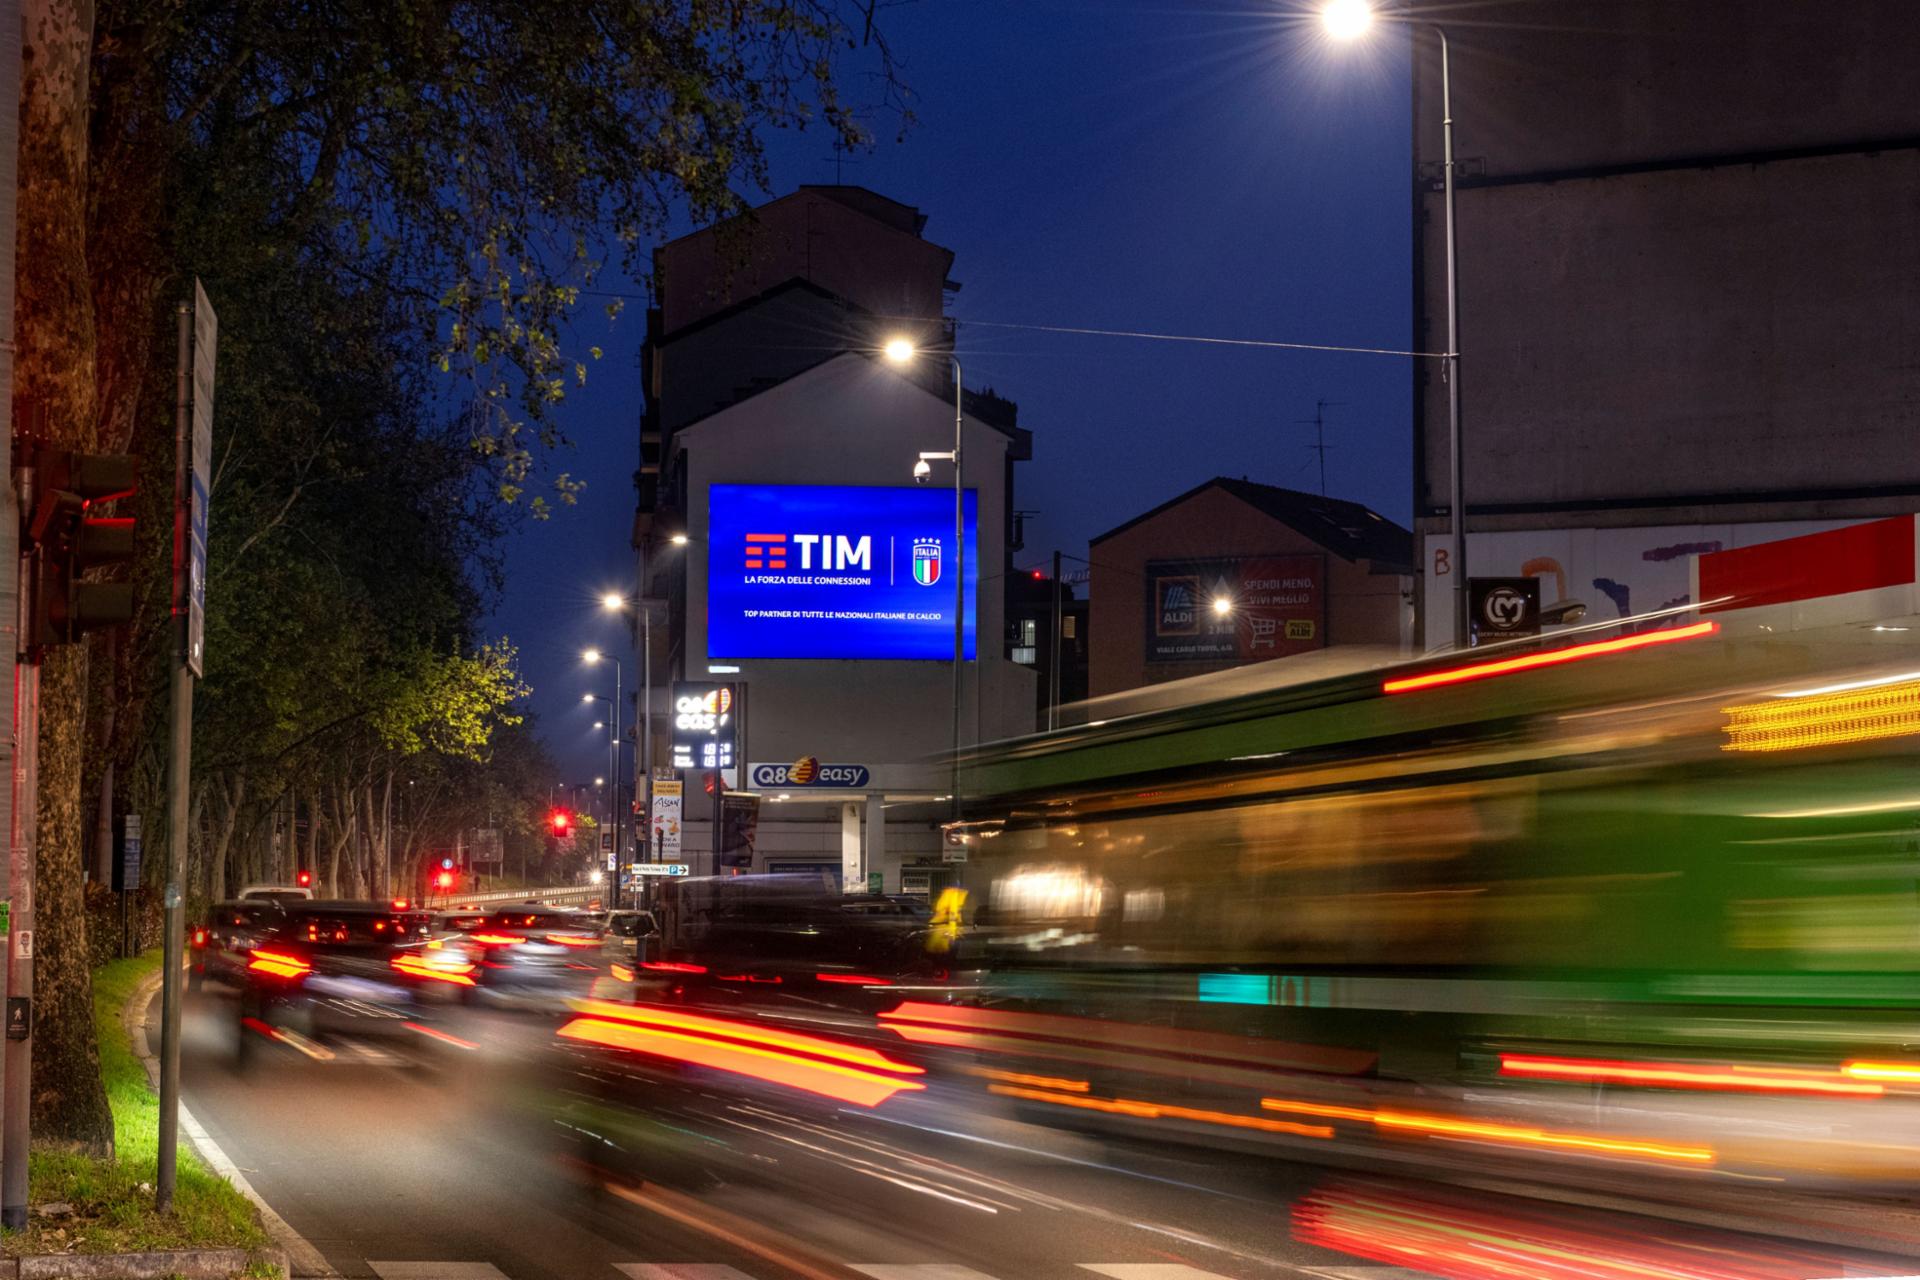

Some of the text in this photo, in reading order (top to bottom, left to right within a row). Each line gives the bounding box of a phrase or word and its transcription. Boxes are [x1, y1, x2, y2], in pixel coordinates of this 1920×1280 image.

[794, 534, 871, 570] TIM
[915, 547, 939, 557] ITALIA
[744, 575, 871, 586] LA FORZA DELLE CONNESSIONI
[1244, 577, 1314, 589] SPENDI MENO,
[1250, 594, 1309, 605] VIVI MEGLIO
[744, 609, 758, 618] TOP
[759, 610, 792, 618] PARTNER
[793, 610, 801, 618] DI
[801, 610, 824, 618] TUTTE
[835, 611, 874, 619] NAZIONALI
[874, 612, 906, 620] ITALIANE
[907, 612, 915, 620] DI
[915, 612, 941, 620] CALCIO
[1163, 612, 1193, 624] ALDI
[758, 767, 863, 785] Q8 easy
